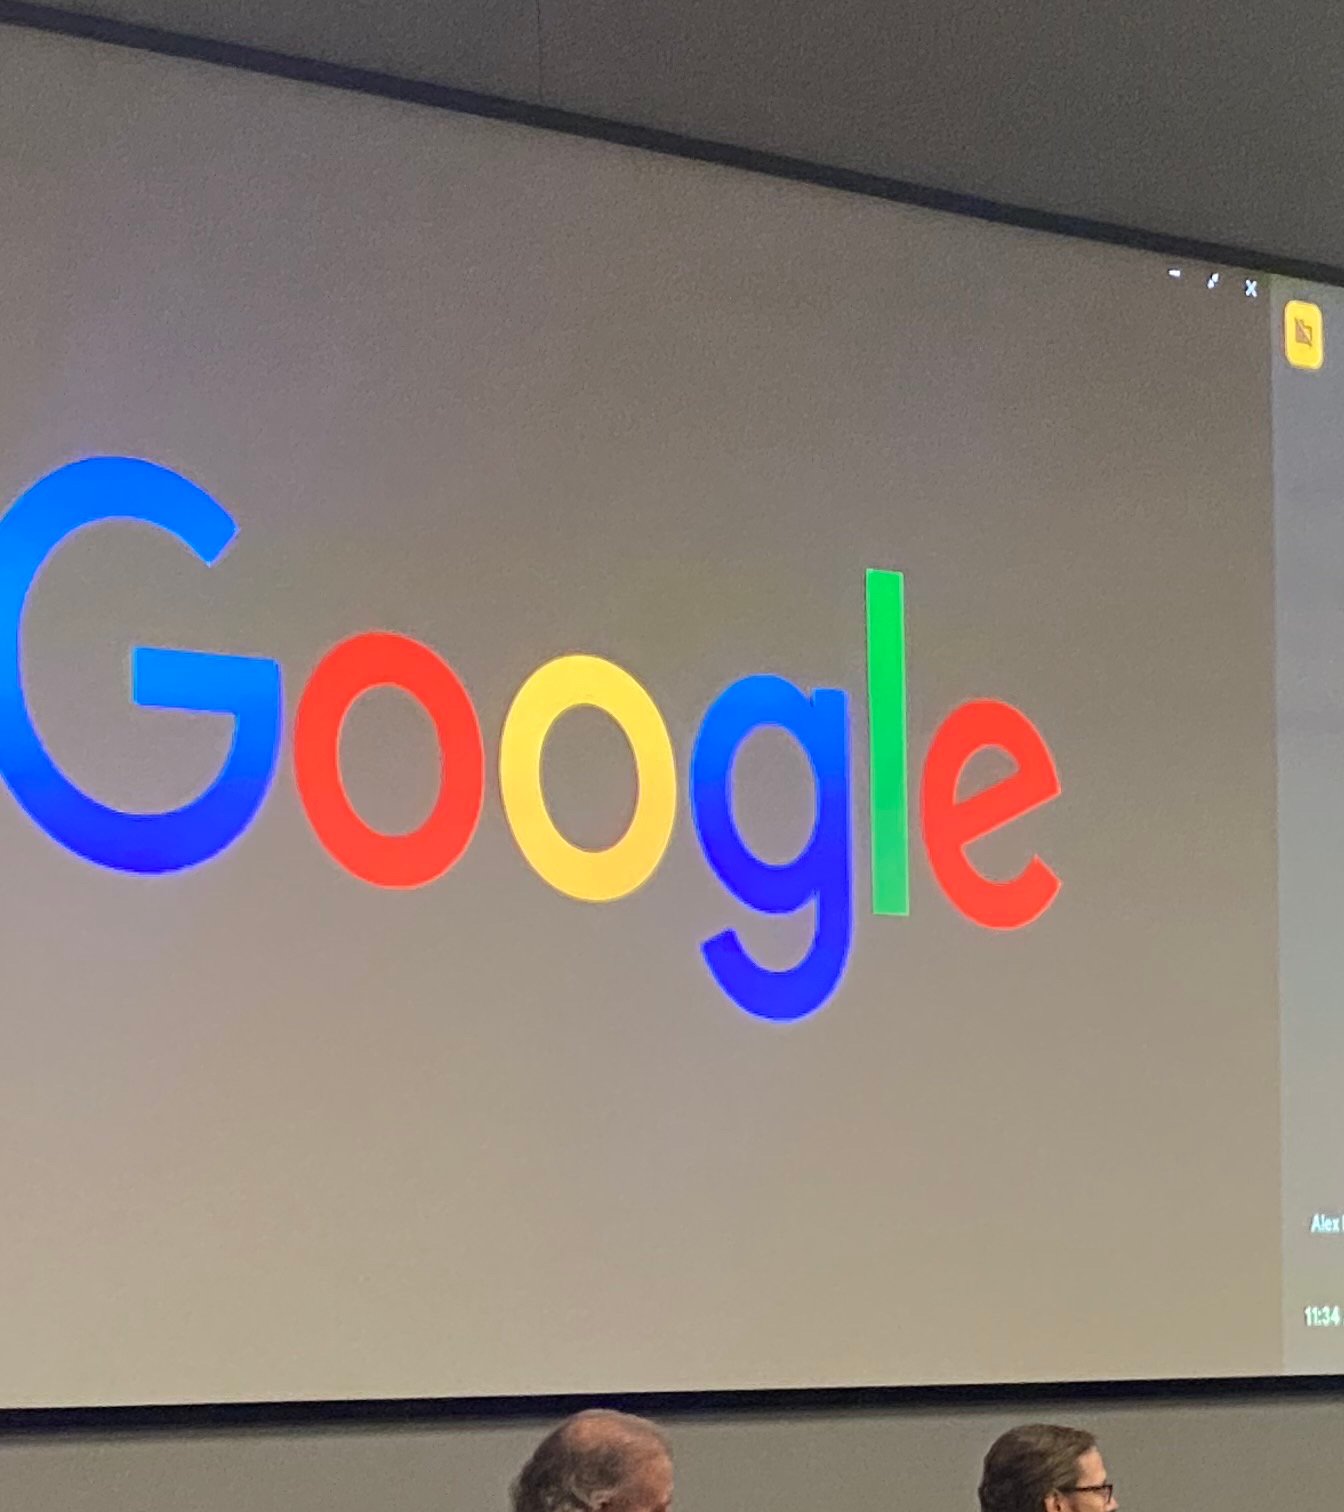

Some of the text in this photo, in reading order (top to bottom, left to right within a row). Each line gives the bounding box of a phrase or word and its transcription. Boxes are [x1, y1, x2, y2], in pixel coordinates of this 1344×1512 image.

[0, 455, 1061, 1022] Google
[1311, 1213, 1340, 1233] Alex
[1304, 1305, 1340, 1326] 11:34
